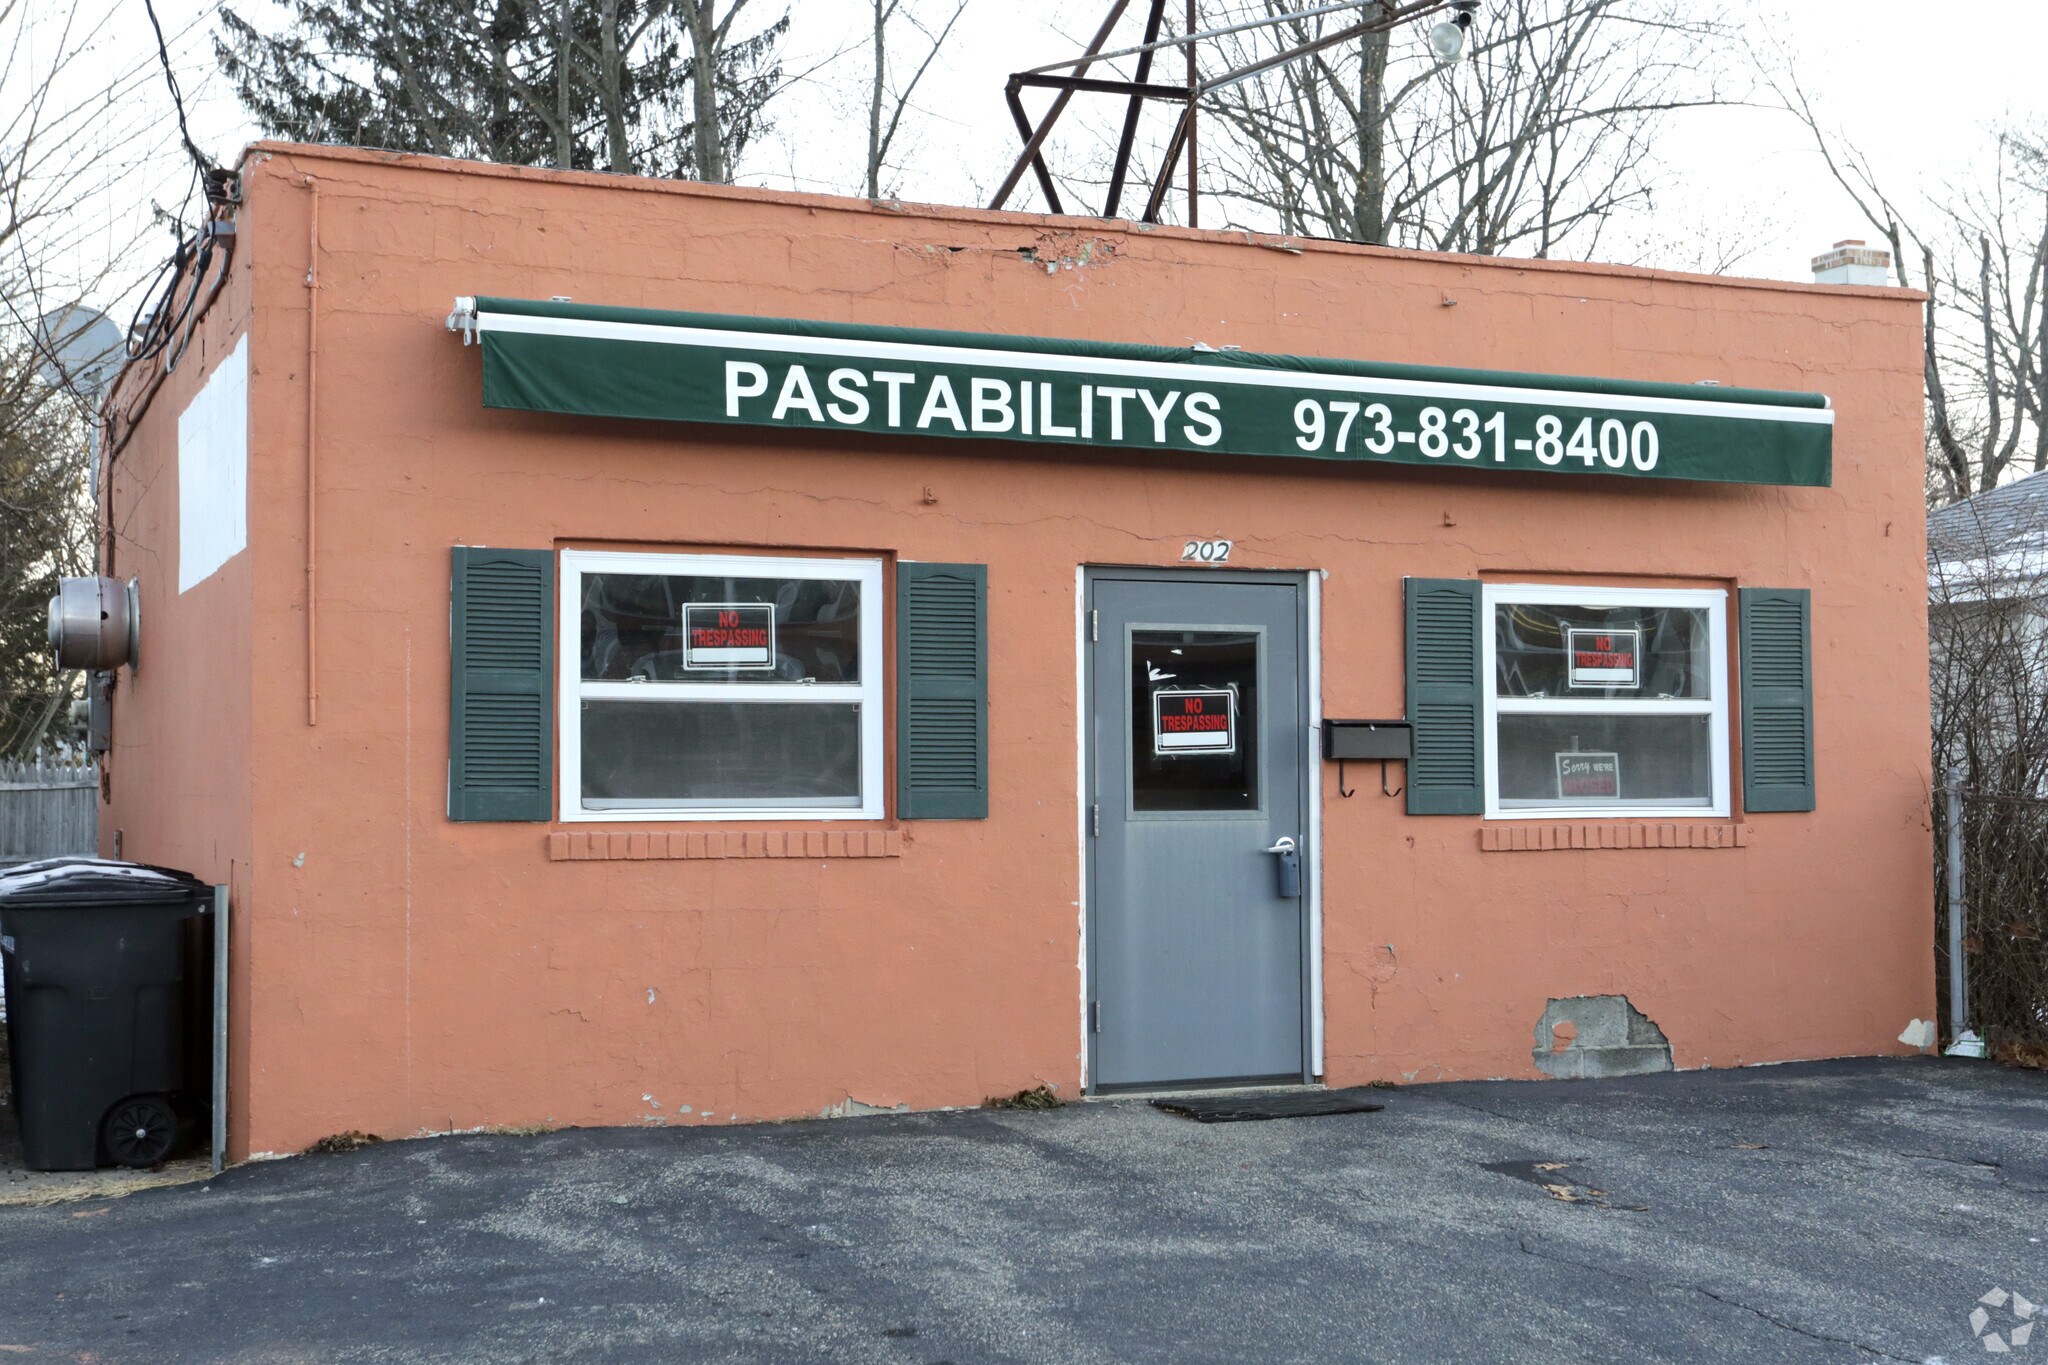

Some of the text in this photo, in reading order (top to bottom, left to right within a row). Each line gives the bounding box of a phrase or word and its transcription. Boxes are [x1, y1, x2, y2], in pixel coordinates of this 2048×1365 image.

[725, 360, 1660, 472] PASTABILITYS 973-831-8400
[1182, 541, 1230, 562] 202
[718, 610, 740, 628] NO
[692, 629, 767, 647] TRESPASSING
[1595, 635, 1612, 652] NO
[1576, 652, 1633, 668] TRESPASSING
[1184, 697, 1203, 714] NO
[1162, 714, 1227, 731] TRESPASSING
[1562, 759, 1614, 775] Sorry WE'RE
